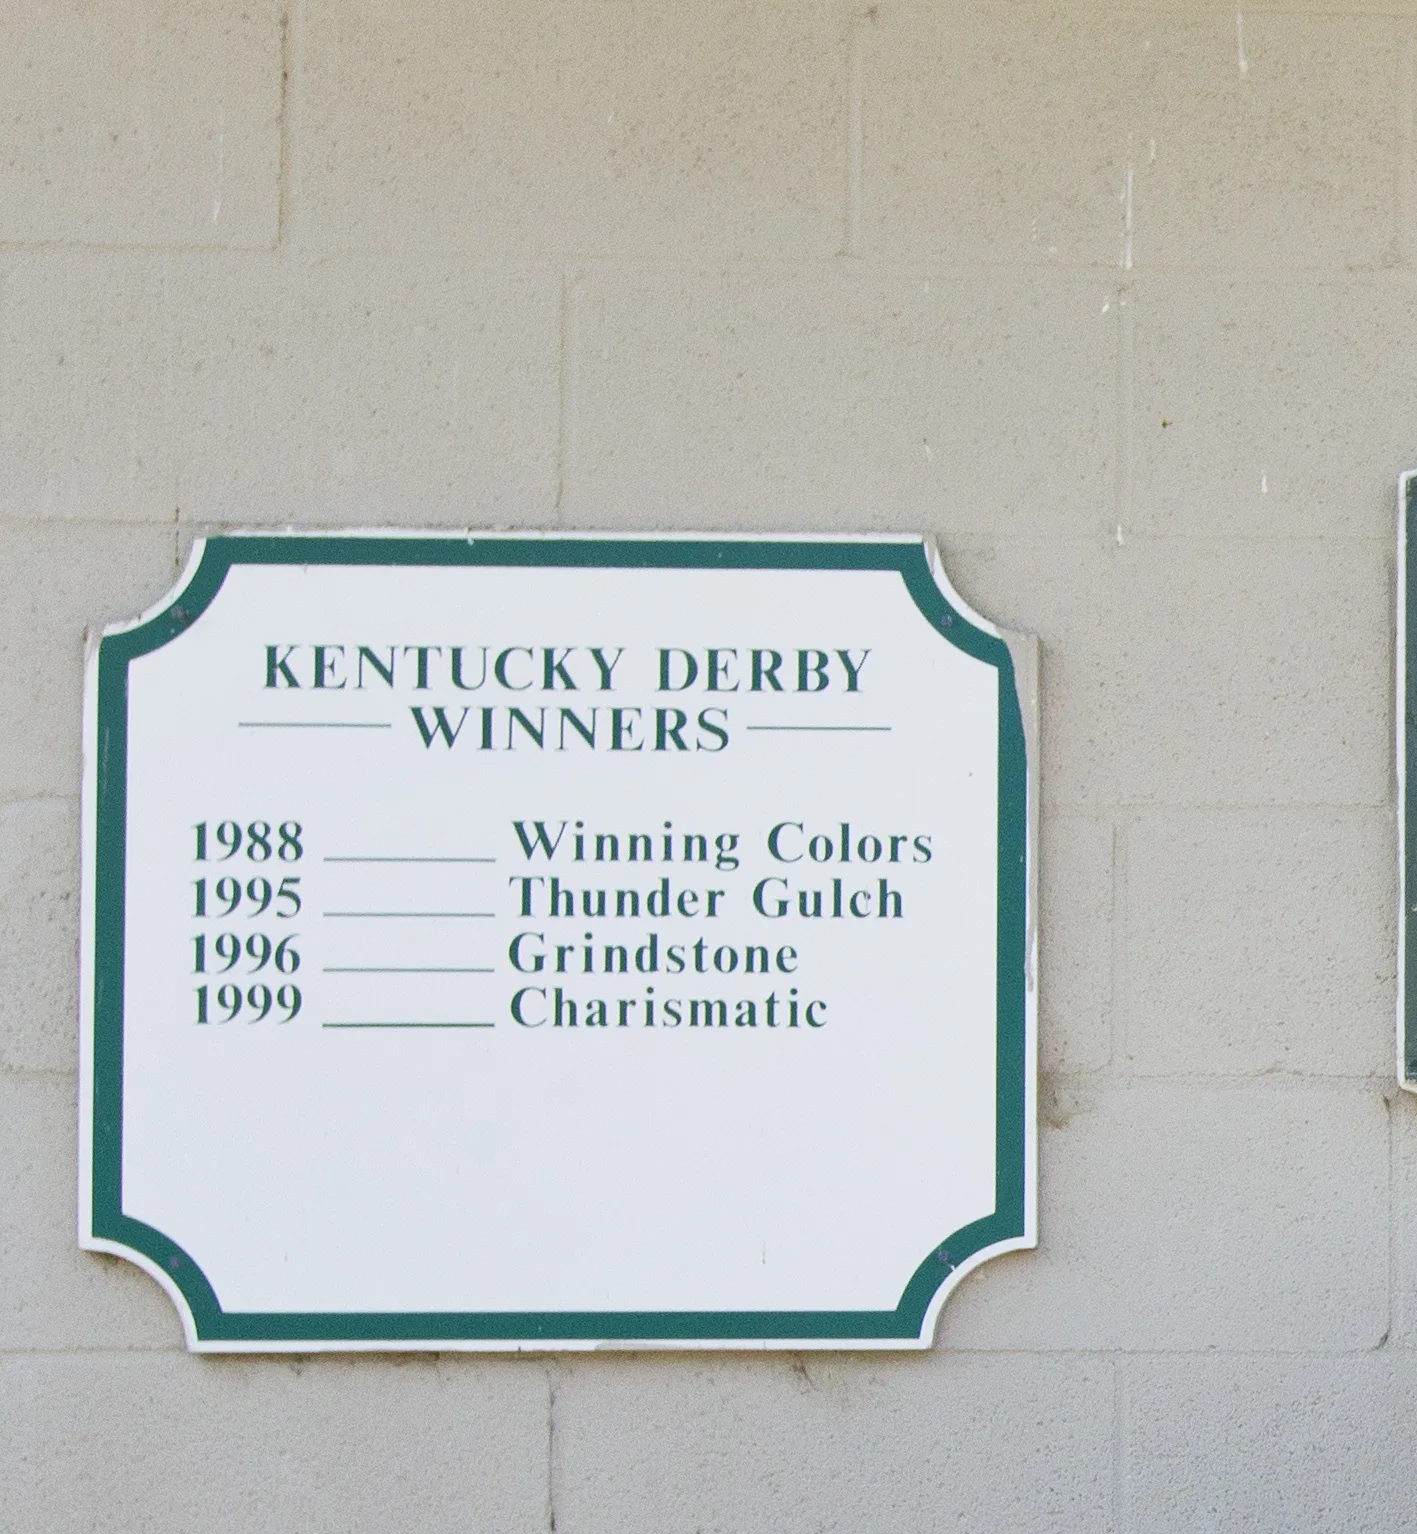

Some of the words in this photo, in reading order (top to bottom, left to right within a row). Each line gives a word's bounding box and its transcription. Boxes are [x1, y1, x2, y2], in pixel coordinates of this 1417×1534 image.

[265, 645, 624, 691] KENTUCKY
[658, 648, 870, 693] DERBY
[410, 706, 729, 752] WINNERS
[192, 821, 304, 862] 1988
[512, 820, 740, 870] Winning
[767, 822, 932, 863] Colors
[191, 876, 302, 918] 1995
[509, 876, 726, 918] Thunder
[752, 877, 903, 919] Gulch
[191, 933, 301, 974] 1996
[508, 931, 798, 974] Grindstone
[194, 984, 302, 1025] 1999
[510, 986, 827, 1028] Charismatic
